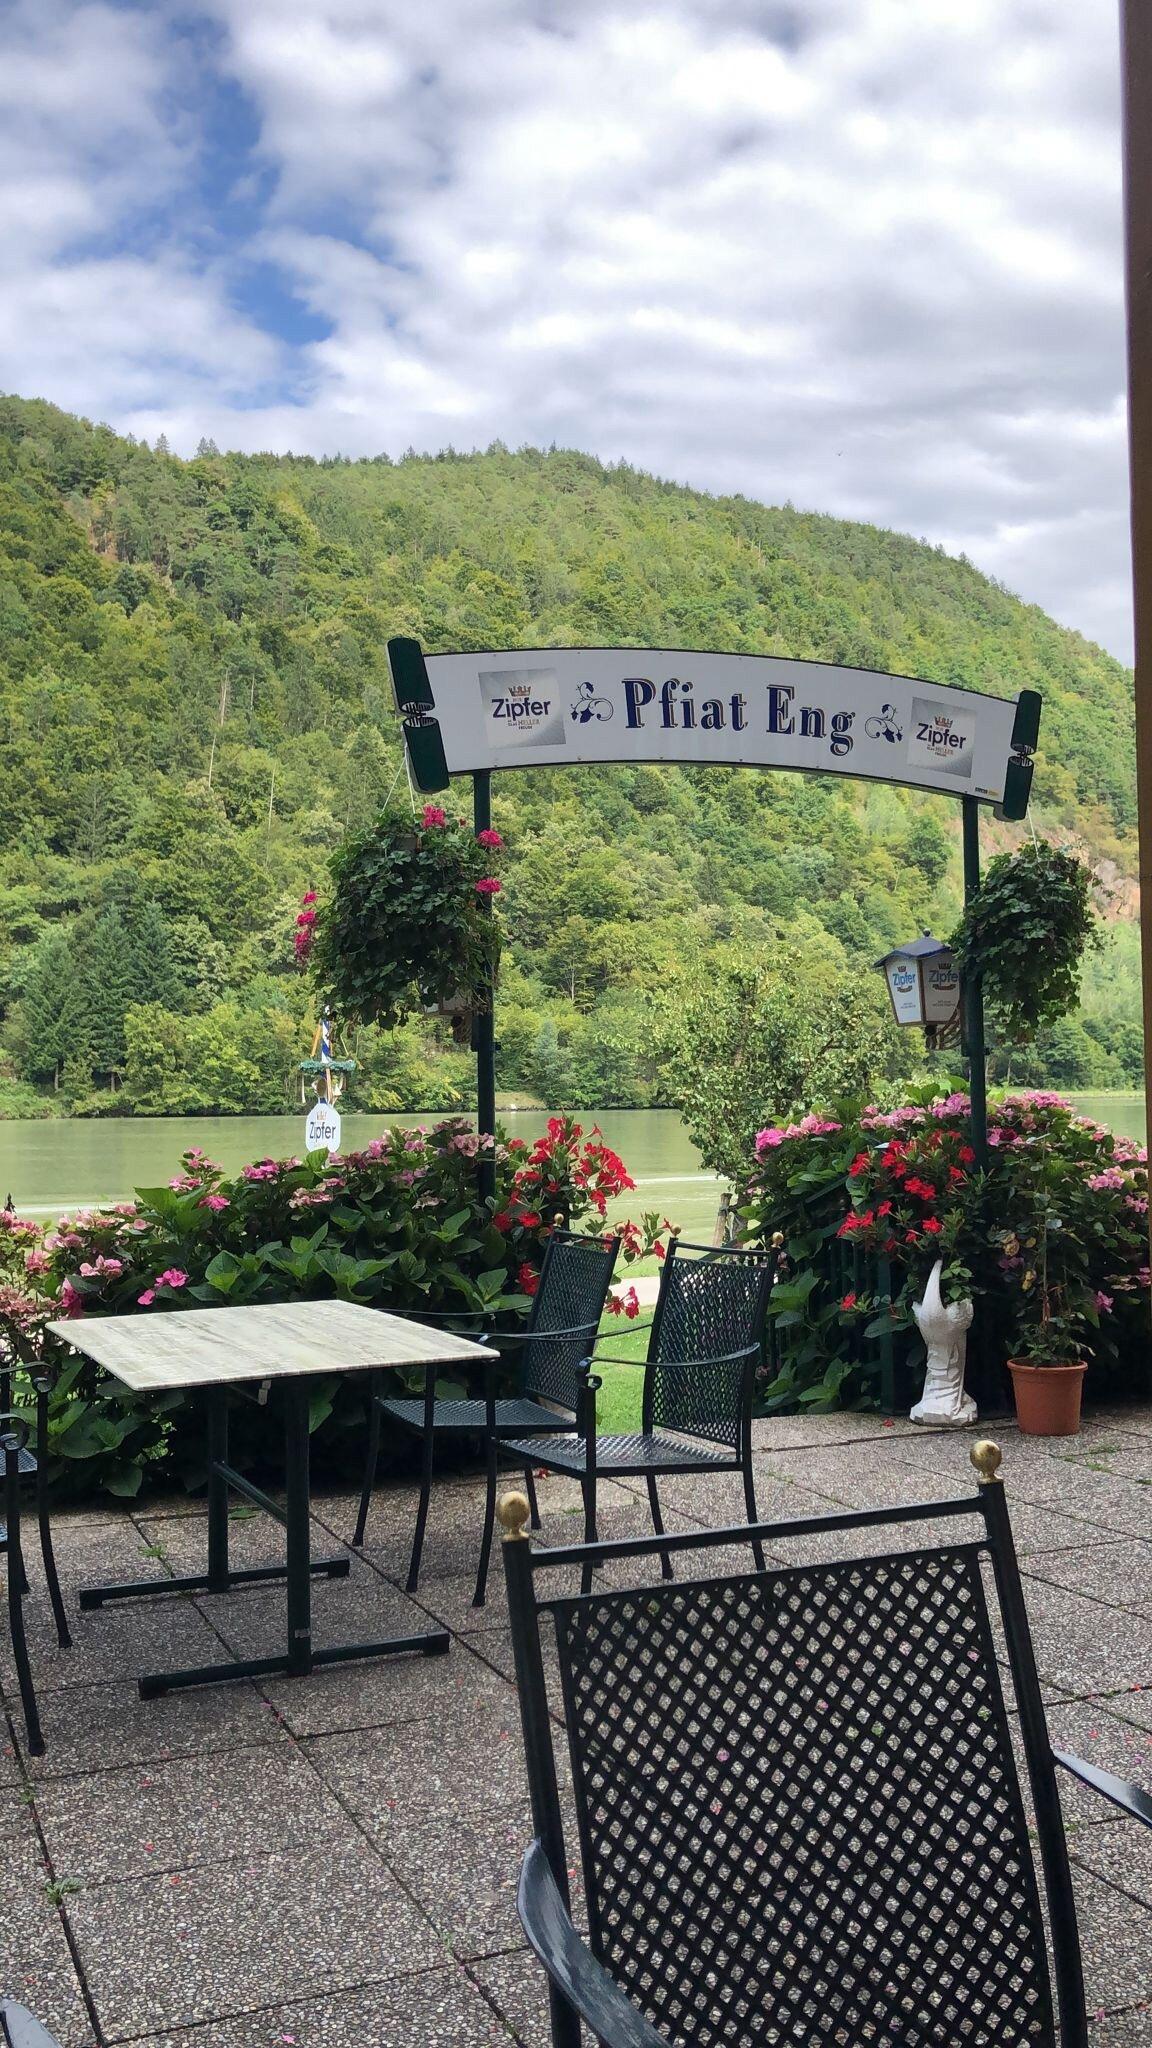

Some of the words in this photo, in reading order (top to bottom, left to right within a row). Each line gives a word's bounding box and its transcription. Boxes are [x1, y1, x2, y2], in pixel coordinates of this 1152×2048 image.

[491, 697, 551, 721] Zipfer
[621, 678, 748, 731] Pfiat
[766, 684, 856, 756] Eng
[916, 722, 966, 749] Zipfer
[892, 972, 915, 987] Zipfer
[928, 970, 960, 985] Zipfe
[309, 1121, 337, 1143] Zipfer
